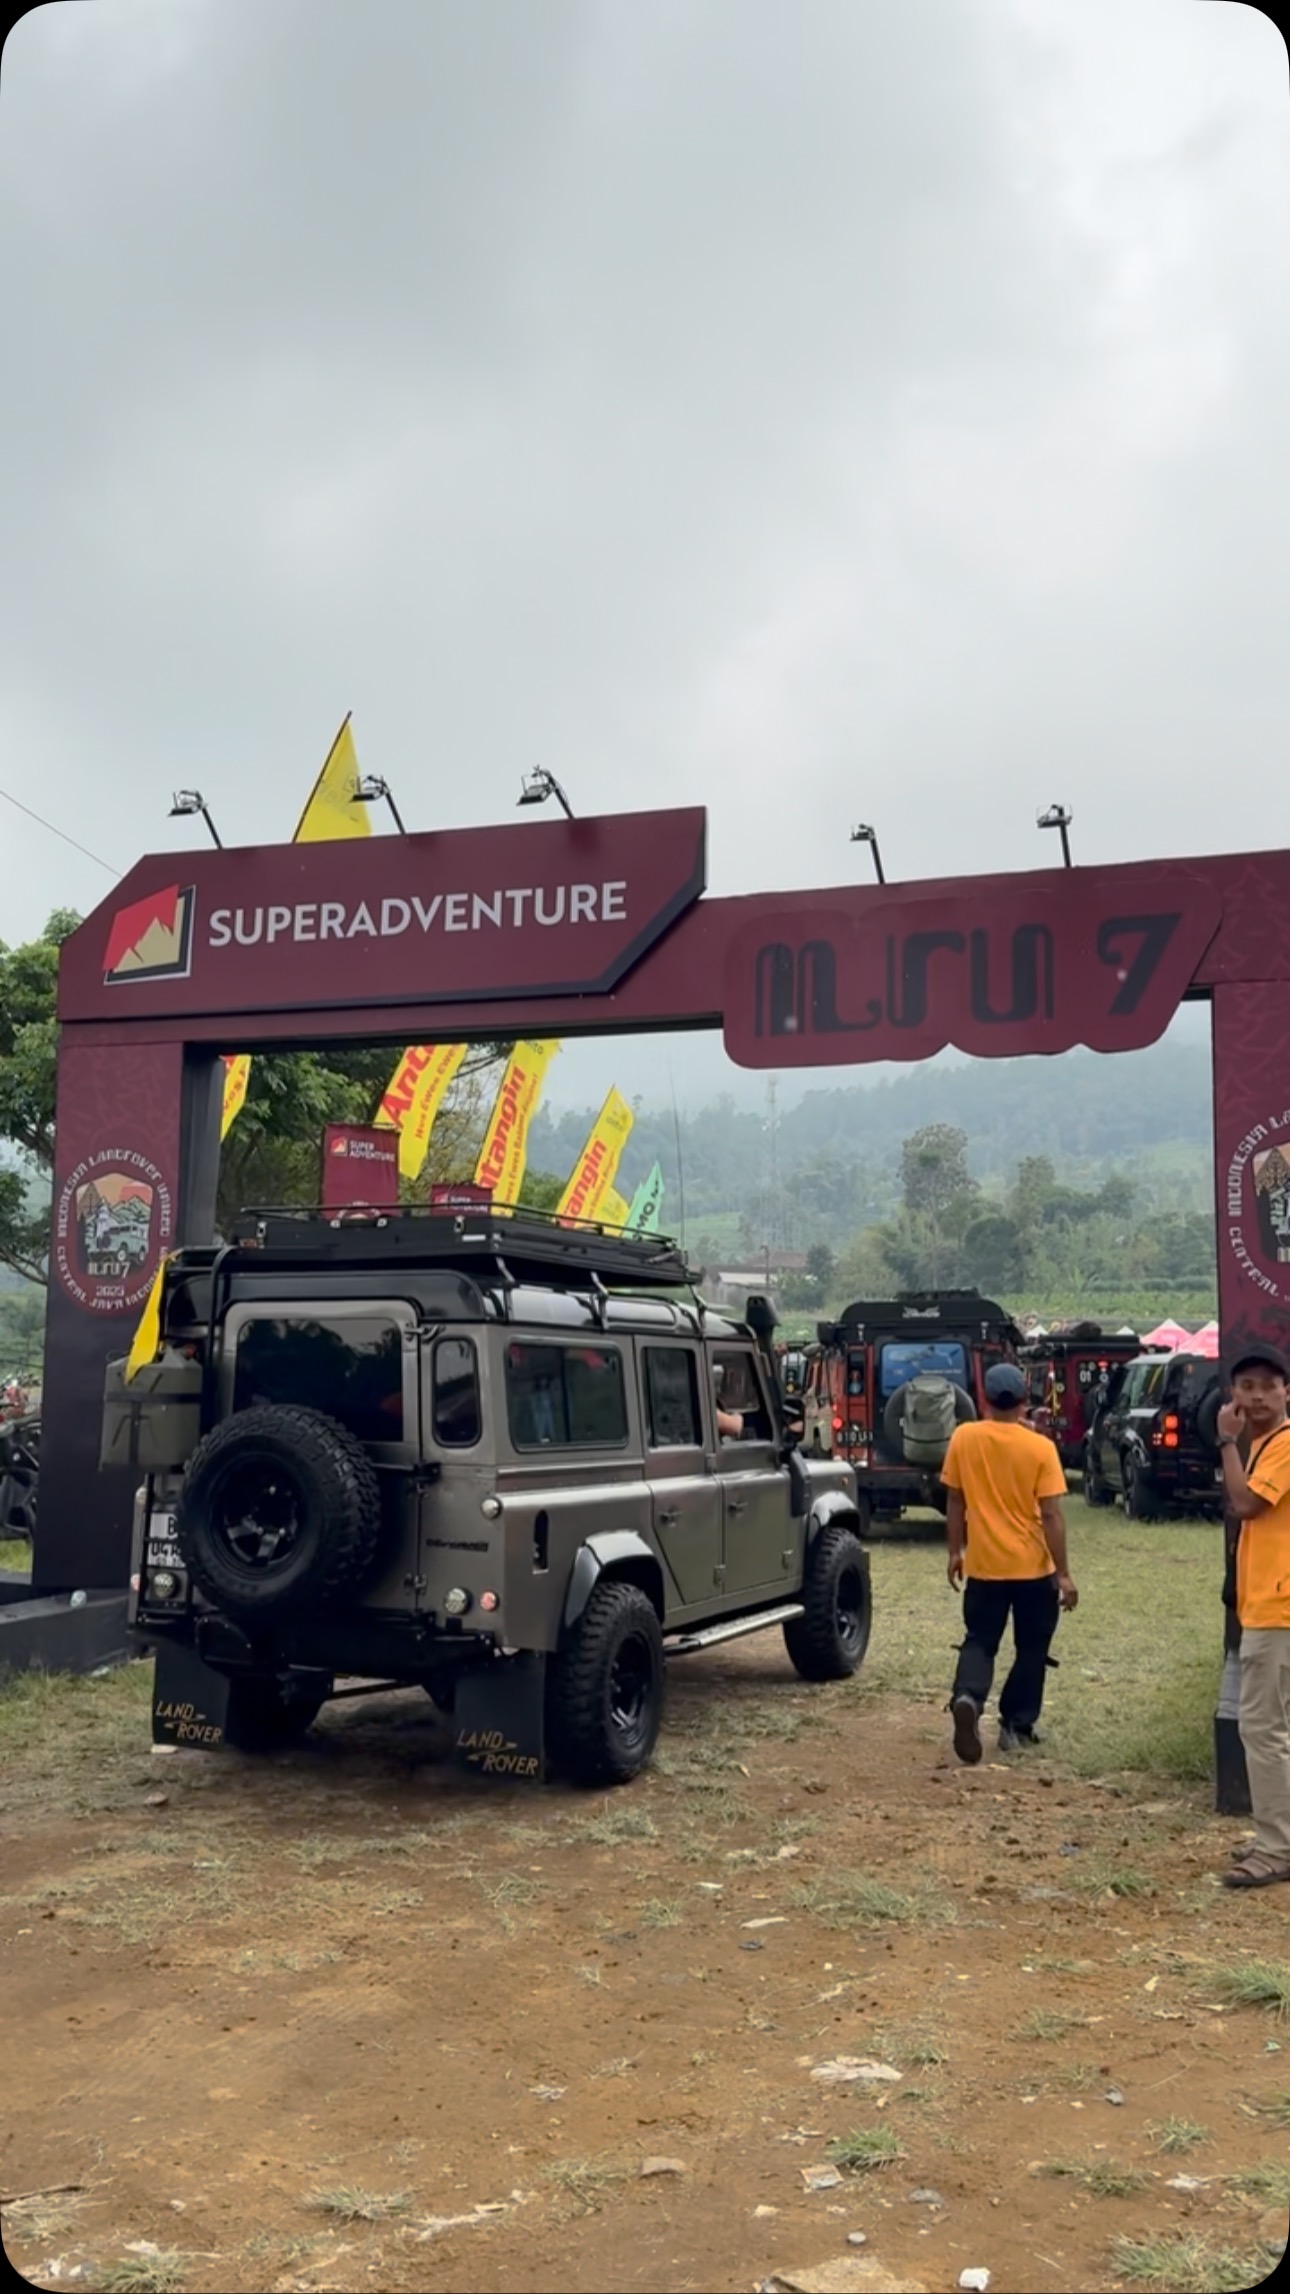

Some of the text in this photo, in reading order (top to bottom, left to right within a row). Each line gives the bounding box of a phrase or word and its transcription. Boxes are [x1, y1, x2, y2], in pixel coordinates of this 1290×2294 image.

[209, 880, 627, 948] SUPERADVENTURE
[1096, 913, 1182, 1016] 7
[349, 1140, 375, 1152] SUPER
[349, 1150, 396, 1163] ADVENTURE
[156, 1700, 194, 1719] LAND
[177, 1722, 222, 1744] ROVER
[457, 1728, 503, 1748] LAND
[483, 1753, 539, 1776] ROVER
